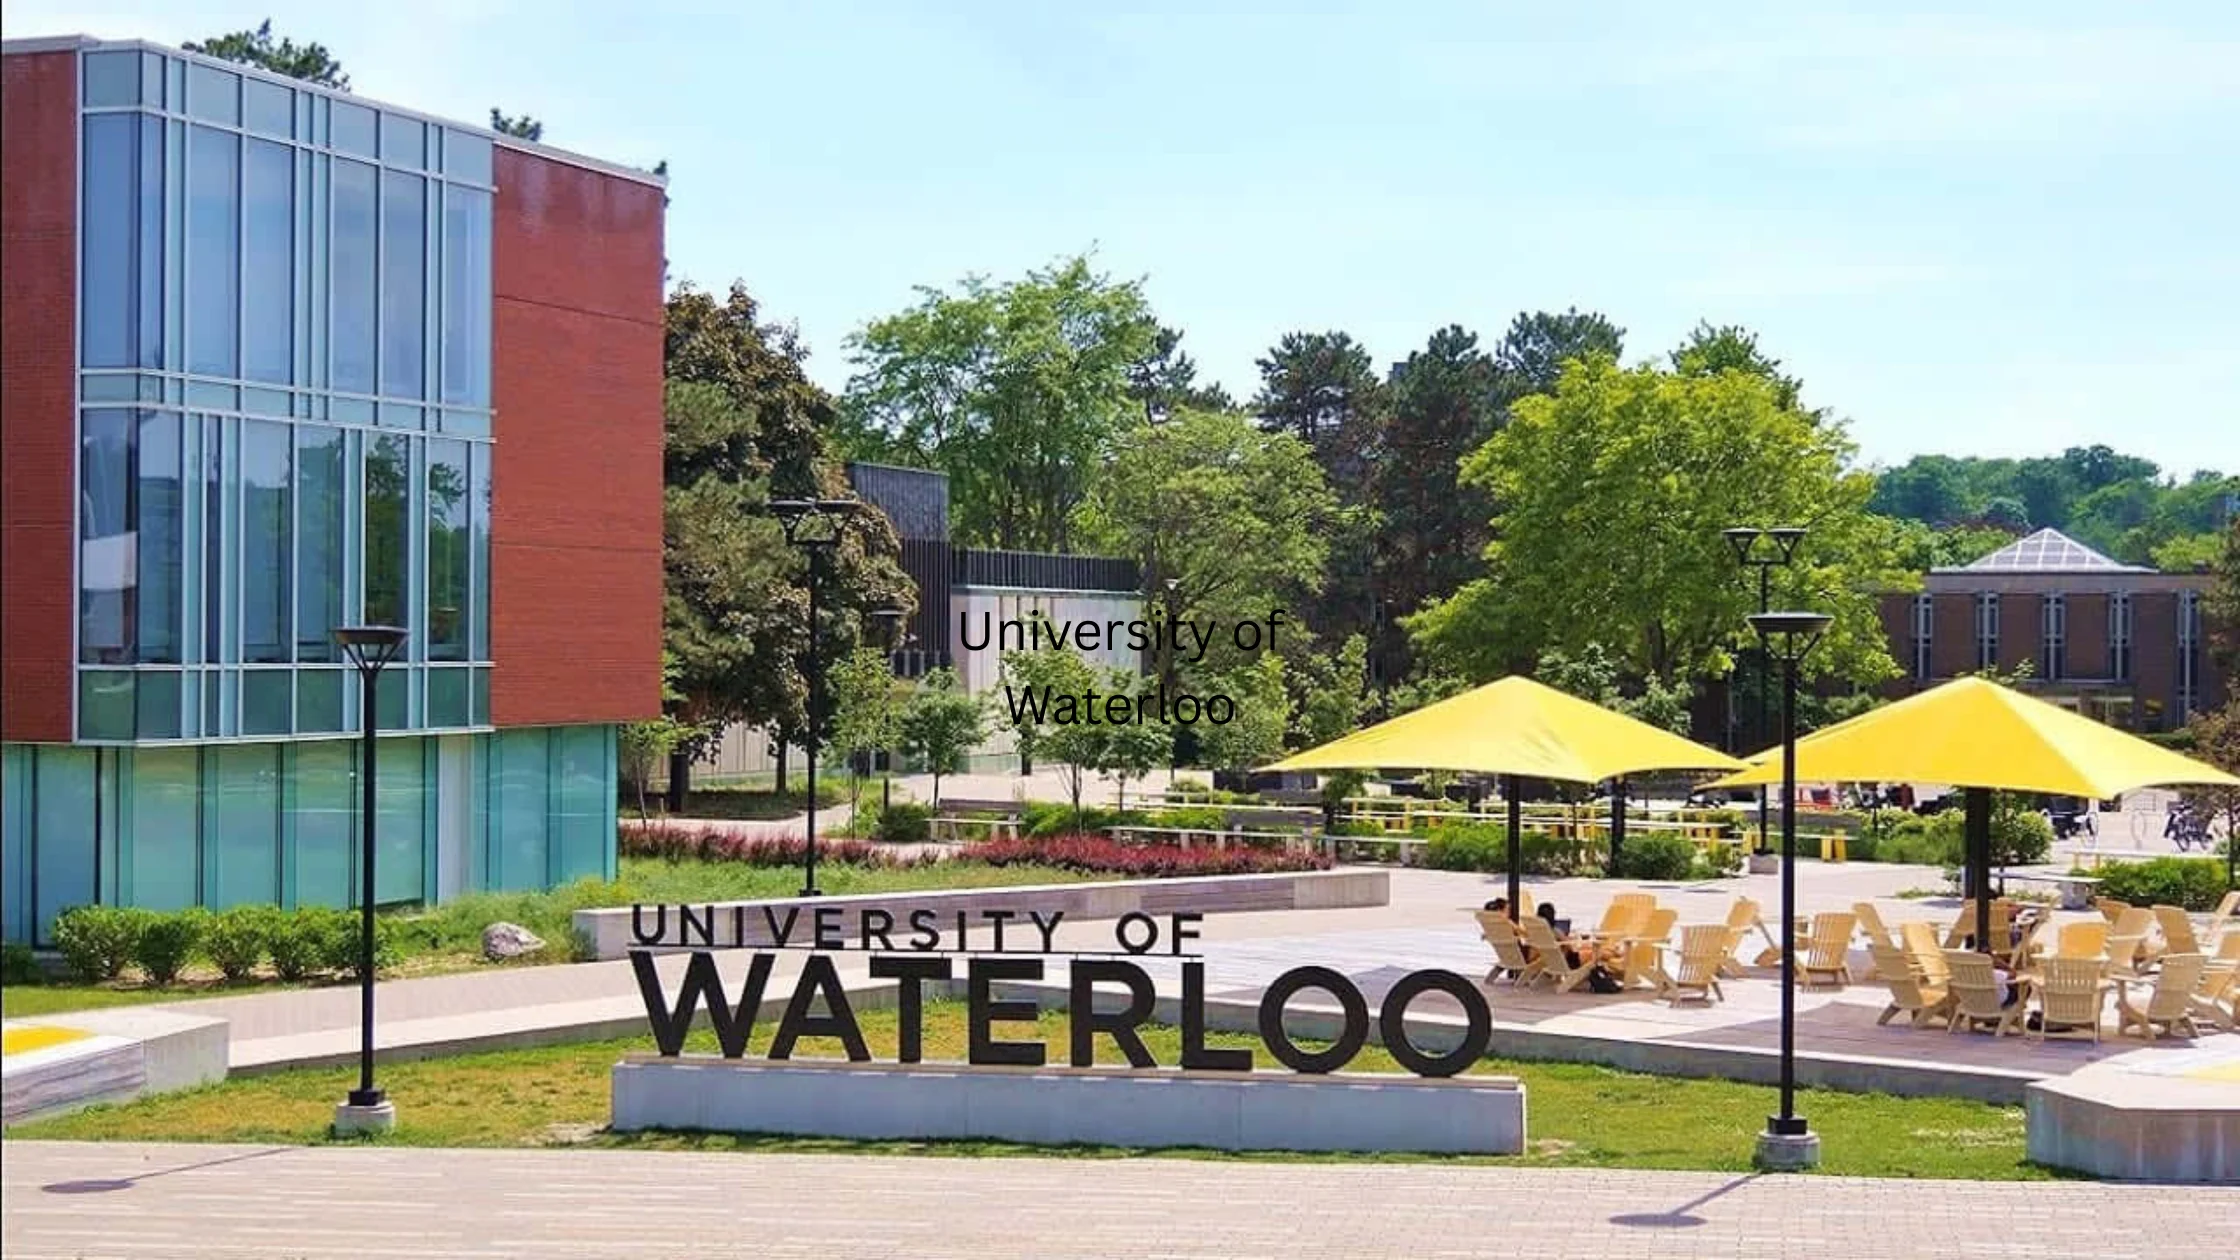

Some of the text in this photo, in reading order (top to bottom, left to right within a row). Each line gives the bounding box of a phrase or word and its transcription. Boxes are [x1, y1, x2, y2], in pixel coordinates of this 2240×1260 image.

[632, 903, 1204, 955] UNIVERSITY OF
[628, 951, 1492, 1078] WATERLOO
